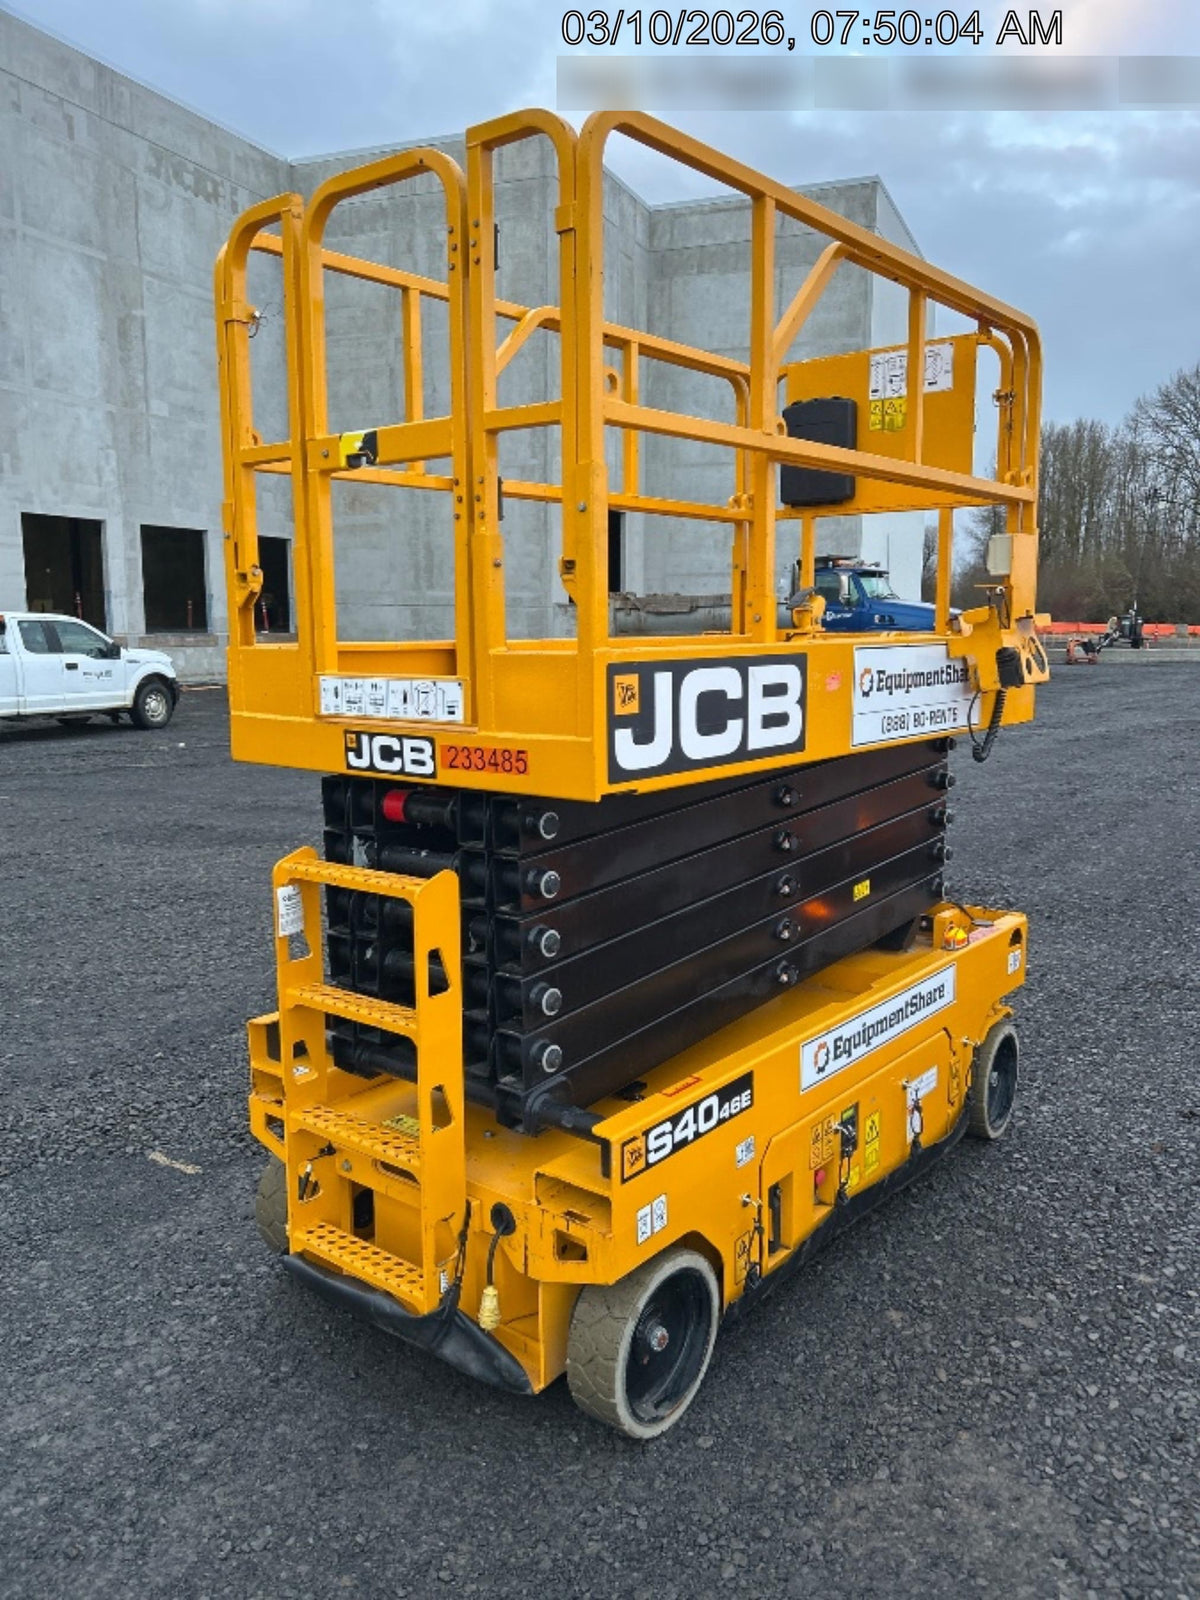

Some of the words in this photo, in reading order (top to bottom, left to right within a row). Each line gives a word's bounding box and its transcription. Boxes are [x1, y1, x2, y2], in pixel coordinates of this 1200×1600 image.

[614, 664, 803, 771] JCB
[347, 734, 435, 775] JCB
[447, 746, 528, 774] 233485
[832, 982, 945, 1061] EquipmentShare
